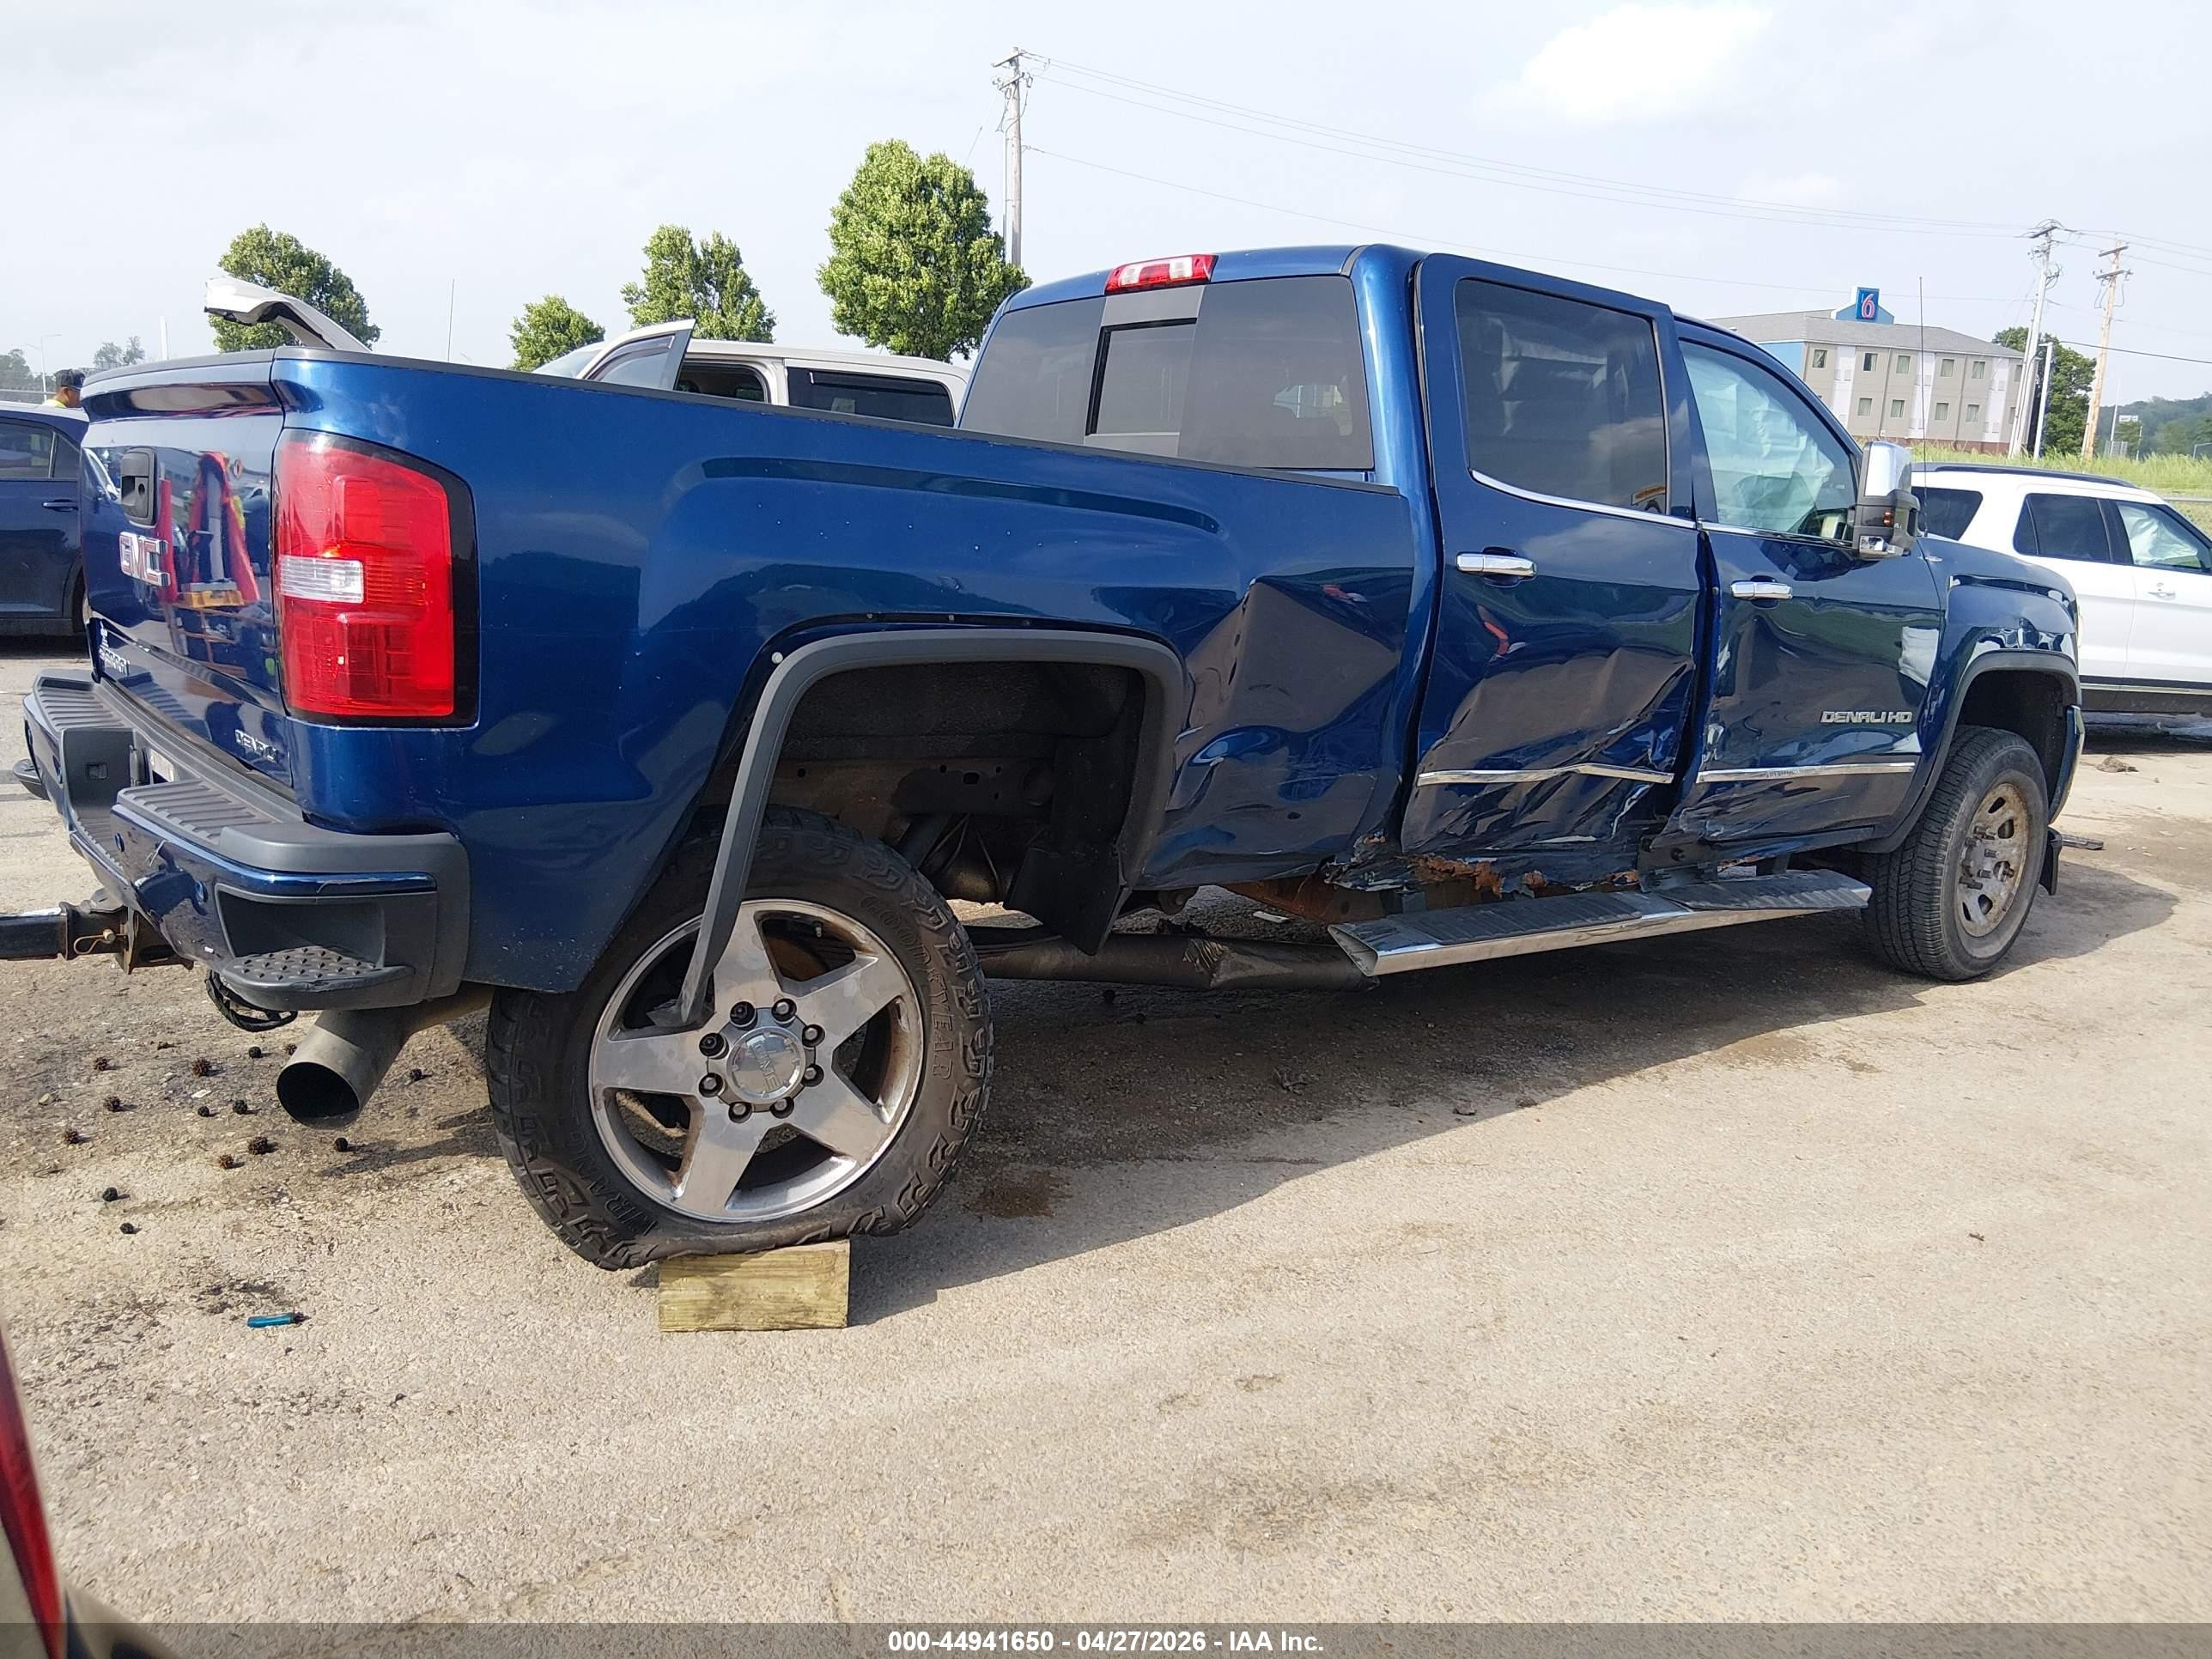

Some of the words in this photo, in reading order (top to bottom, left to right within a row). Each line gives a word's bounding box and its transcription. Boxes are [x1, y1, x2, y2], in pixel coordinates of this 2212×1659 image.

[1861, 292, 1875, 319] 6
[119, 532, 171, 586] GMC
[1820, 710, 1886, 724] DENALI
[1887, 711, 1913, 724] HD
[860, 891, 955, 1080] GOODYEAR
